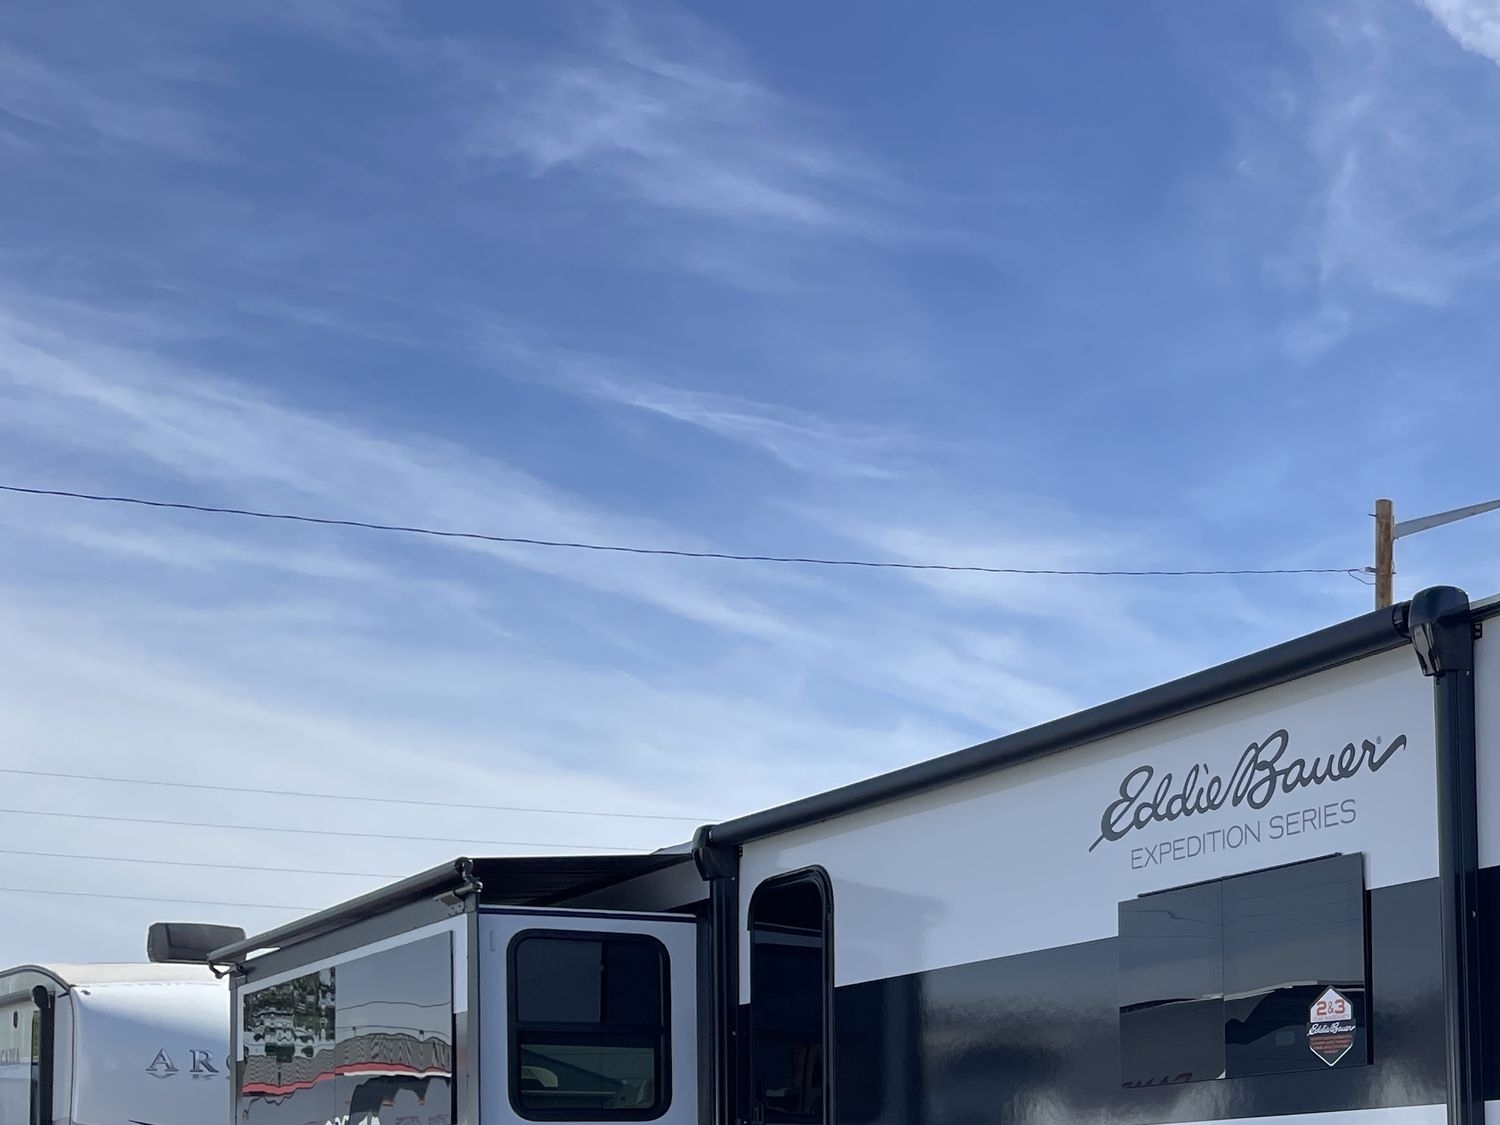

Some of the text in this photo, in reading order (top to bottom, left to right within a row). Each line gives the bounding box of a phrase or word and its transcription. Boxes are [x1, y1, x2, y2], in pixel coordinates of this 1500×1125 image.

[1089, 764, 1234, 852] Eddie
[1131, 799, 1358, 870] EXPEDITION SERIES
[1316, 999, 1346, 1016] 2&3
[145, 1048, 231, 1073] AR
